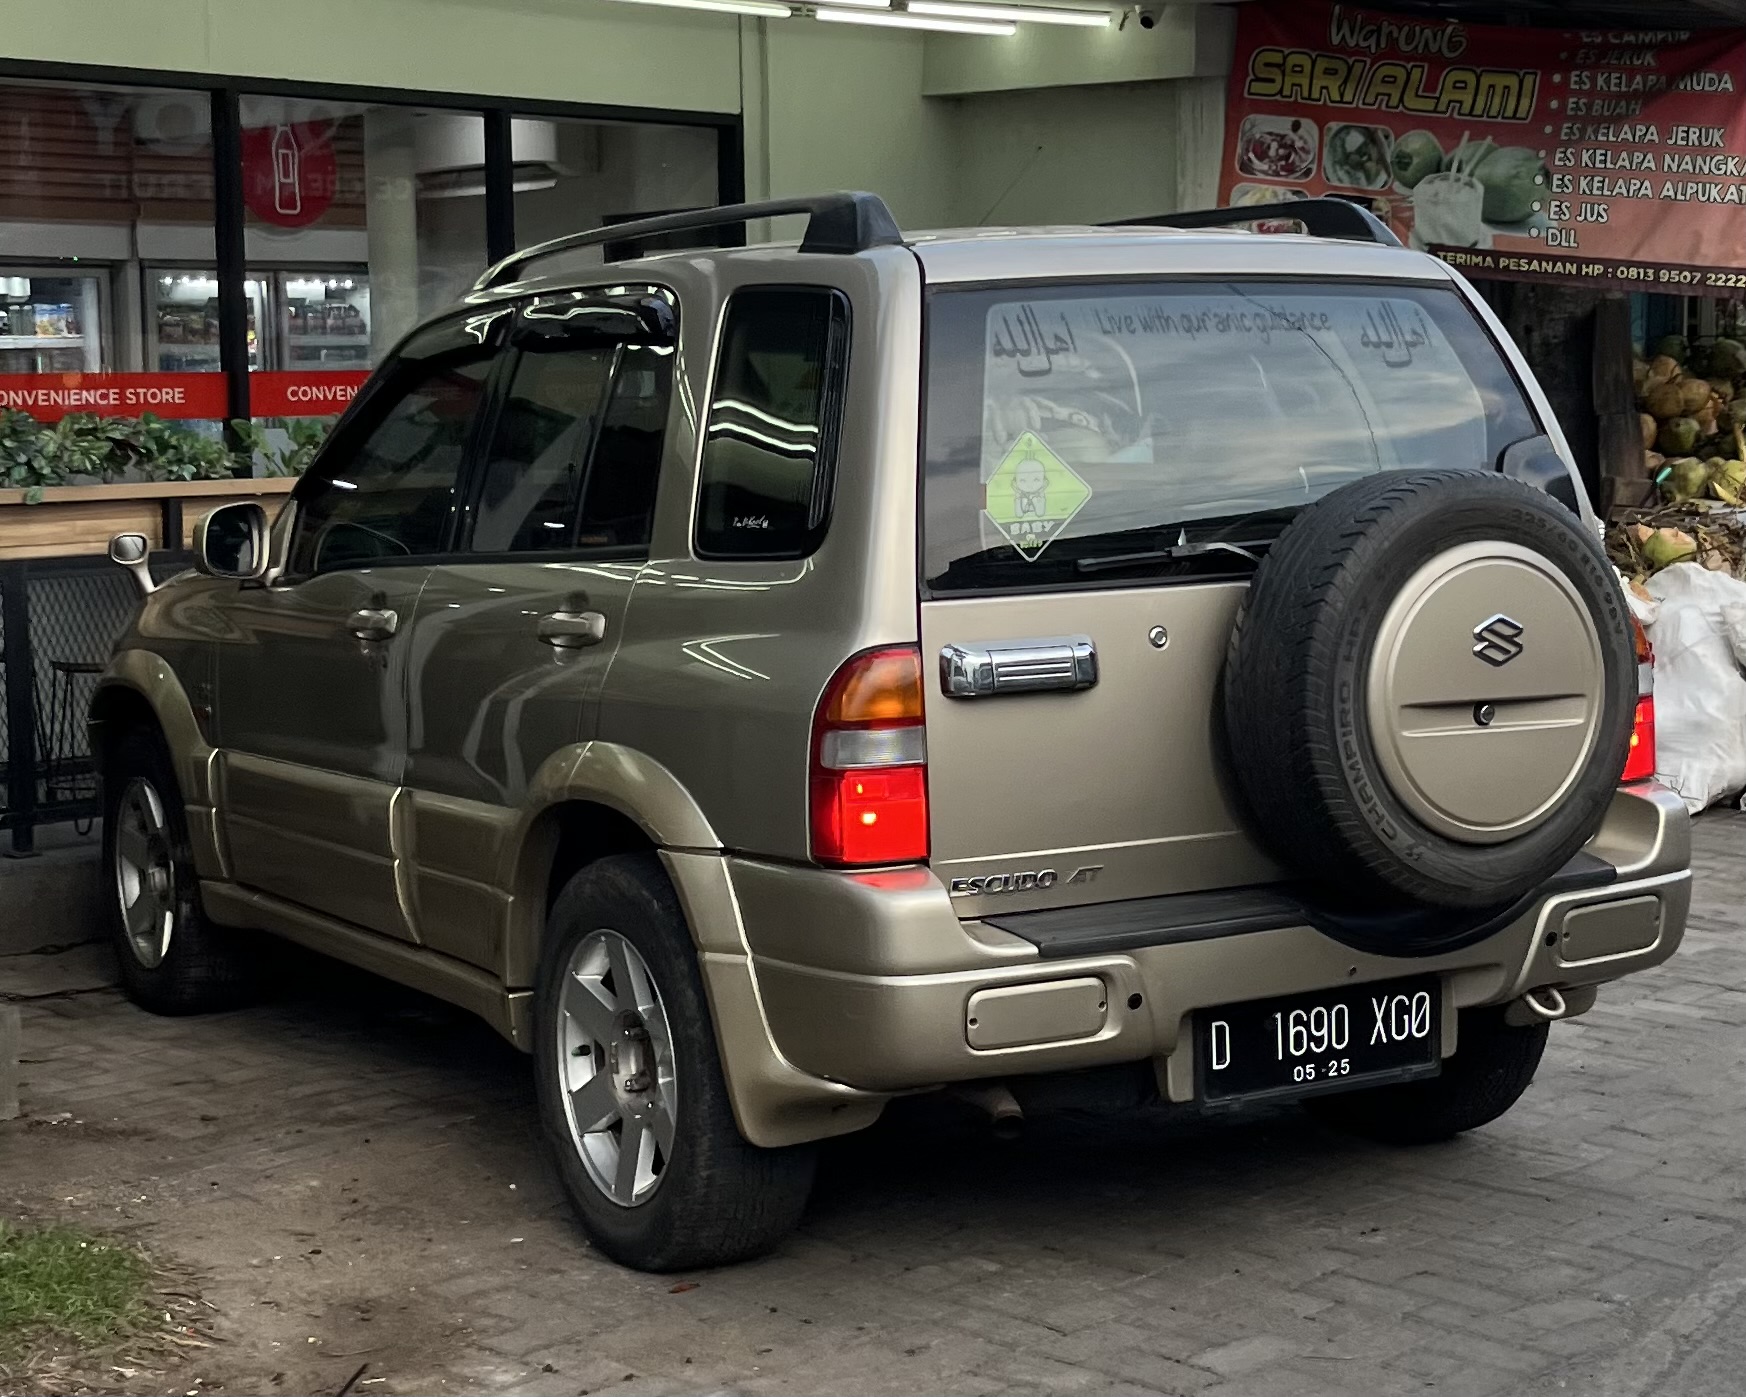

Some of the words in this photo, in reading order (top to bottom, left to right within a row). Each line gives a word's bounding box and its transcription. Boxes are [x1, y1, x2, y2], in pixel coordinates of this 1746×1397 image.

[1600, 50, 1657, 67] JERUK
[1362, 64, 1540, 123] ALAMI
[1570, 70, 1591, 91] ES
[1596, 72, 1667, 92] KELAPA
[1672, 71, 1734, 93] MUDA
[1566, 97, 1588, 116] ES
[1591, 98, 1643, 117] BUAH
[1560, 122, 1582, 141] ES
[1585, 123, 1660, 145] KELAPA
[1666, 126, 1726, 149] JERUK
[1553, 147, 1576, 168] ES
[1580, 149, 1657, 173] KELAPA
[1551, 174, 1574, 194] ES
[1577, 176, 1655, 200] KELAPA
[1660, 180, 1746, 206] ALPUKAT
[1548, 201, 1571, 222] ES
[1575, 203, 1610, 224] JUS
[1546, 229, 1579, 249] DLL
[1437, 252, 1494, 269] TERIMA
[1499, 258, 1577, 277] PESANAN
[1581, 264, 1604, 279] HP
[1616, 266, 1656, 283] 0813
[1659, 271, 1702, 287] 9507
[1705, 274, 1746, 290] 2222
[125, 386, 186, 404] STORE
[949, 868, 1058, 898] ESCUDO
[1210, 1020, 1232, 1071] D
[1273, 1004, 1349, 1061] 1690
